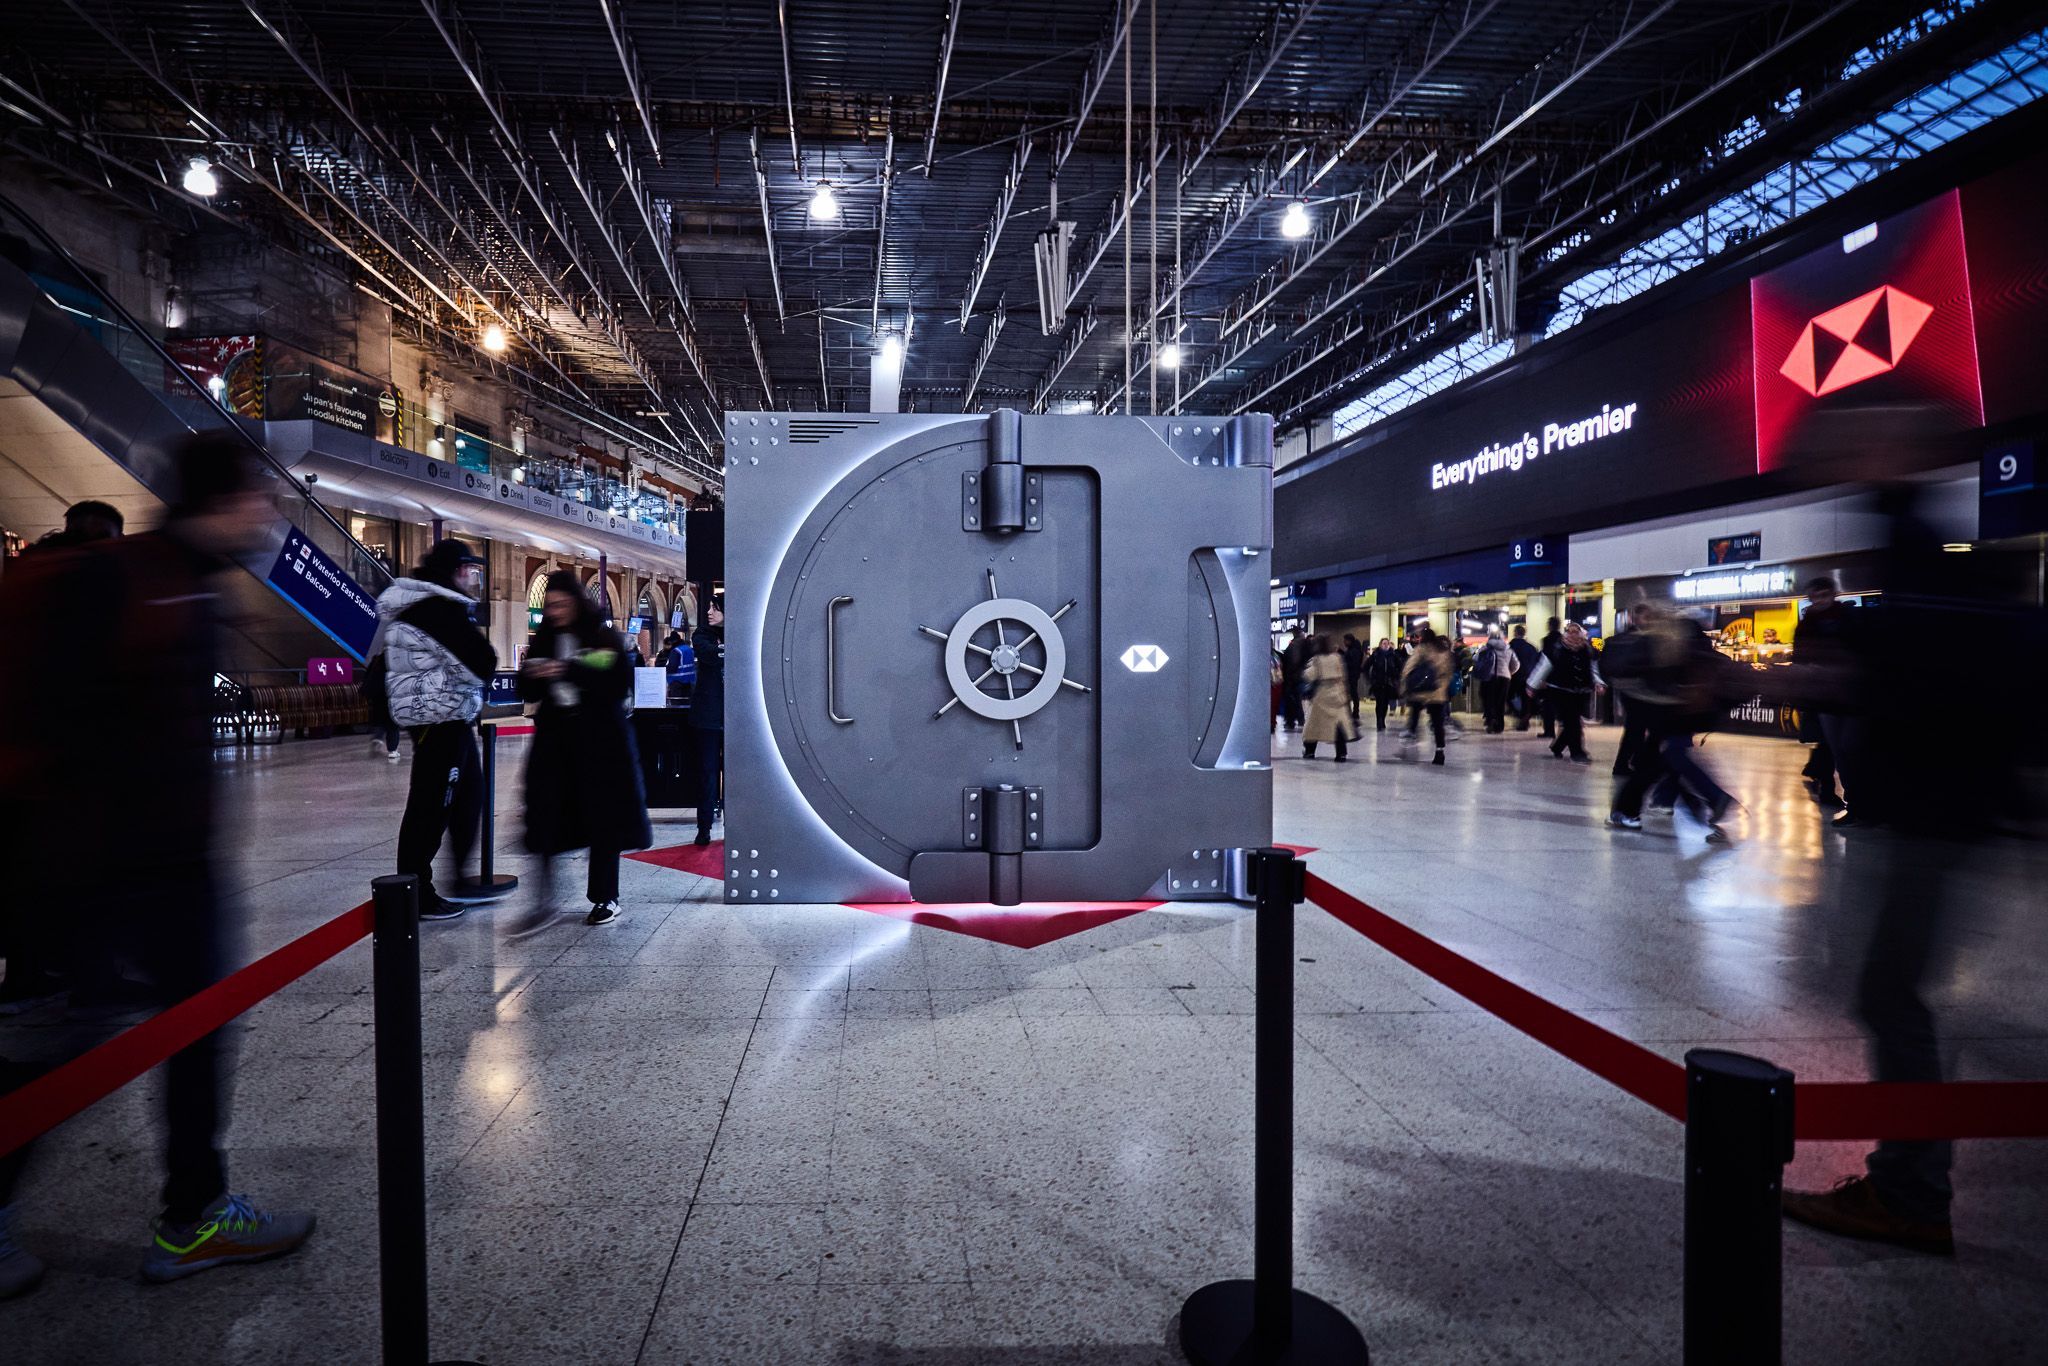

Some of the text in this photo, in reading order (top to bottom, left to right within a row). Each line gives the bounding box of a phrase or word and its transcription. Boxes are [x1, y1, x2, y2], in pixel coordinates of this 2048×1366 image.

[307, 407, 363, 431] noodle kitchen
[334, 402, 367, 421] favourite
[1432, 402, 1637, 489] Everything's Premier
[380, 449, 409, 469] Balcony
[440, 469, 450, 480] Eat
[1999, 454, 2017, 481] 9
[476, 478, 491, 493] Shop
[510, 488, 524, 501] Drink
[533, 496, 553, 511] Balcony
[1534, 543, 1544, 558] 8
[1742, 537, 1760, 548] WiFi
[1515, 544, 1522, 560] 8
[305, 570, 332, 599] Balcony
[312, 556, 376, 619] Waterloo East Station
[1300, 585, 1306, 596] 7
[1742, 707, 1775, 723] LEGEND
